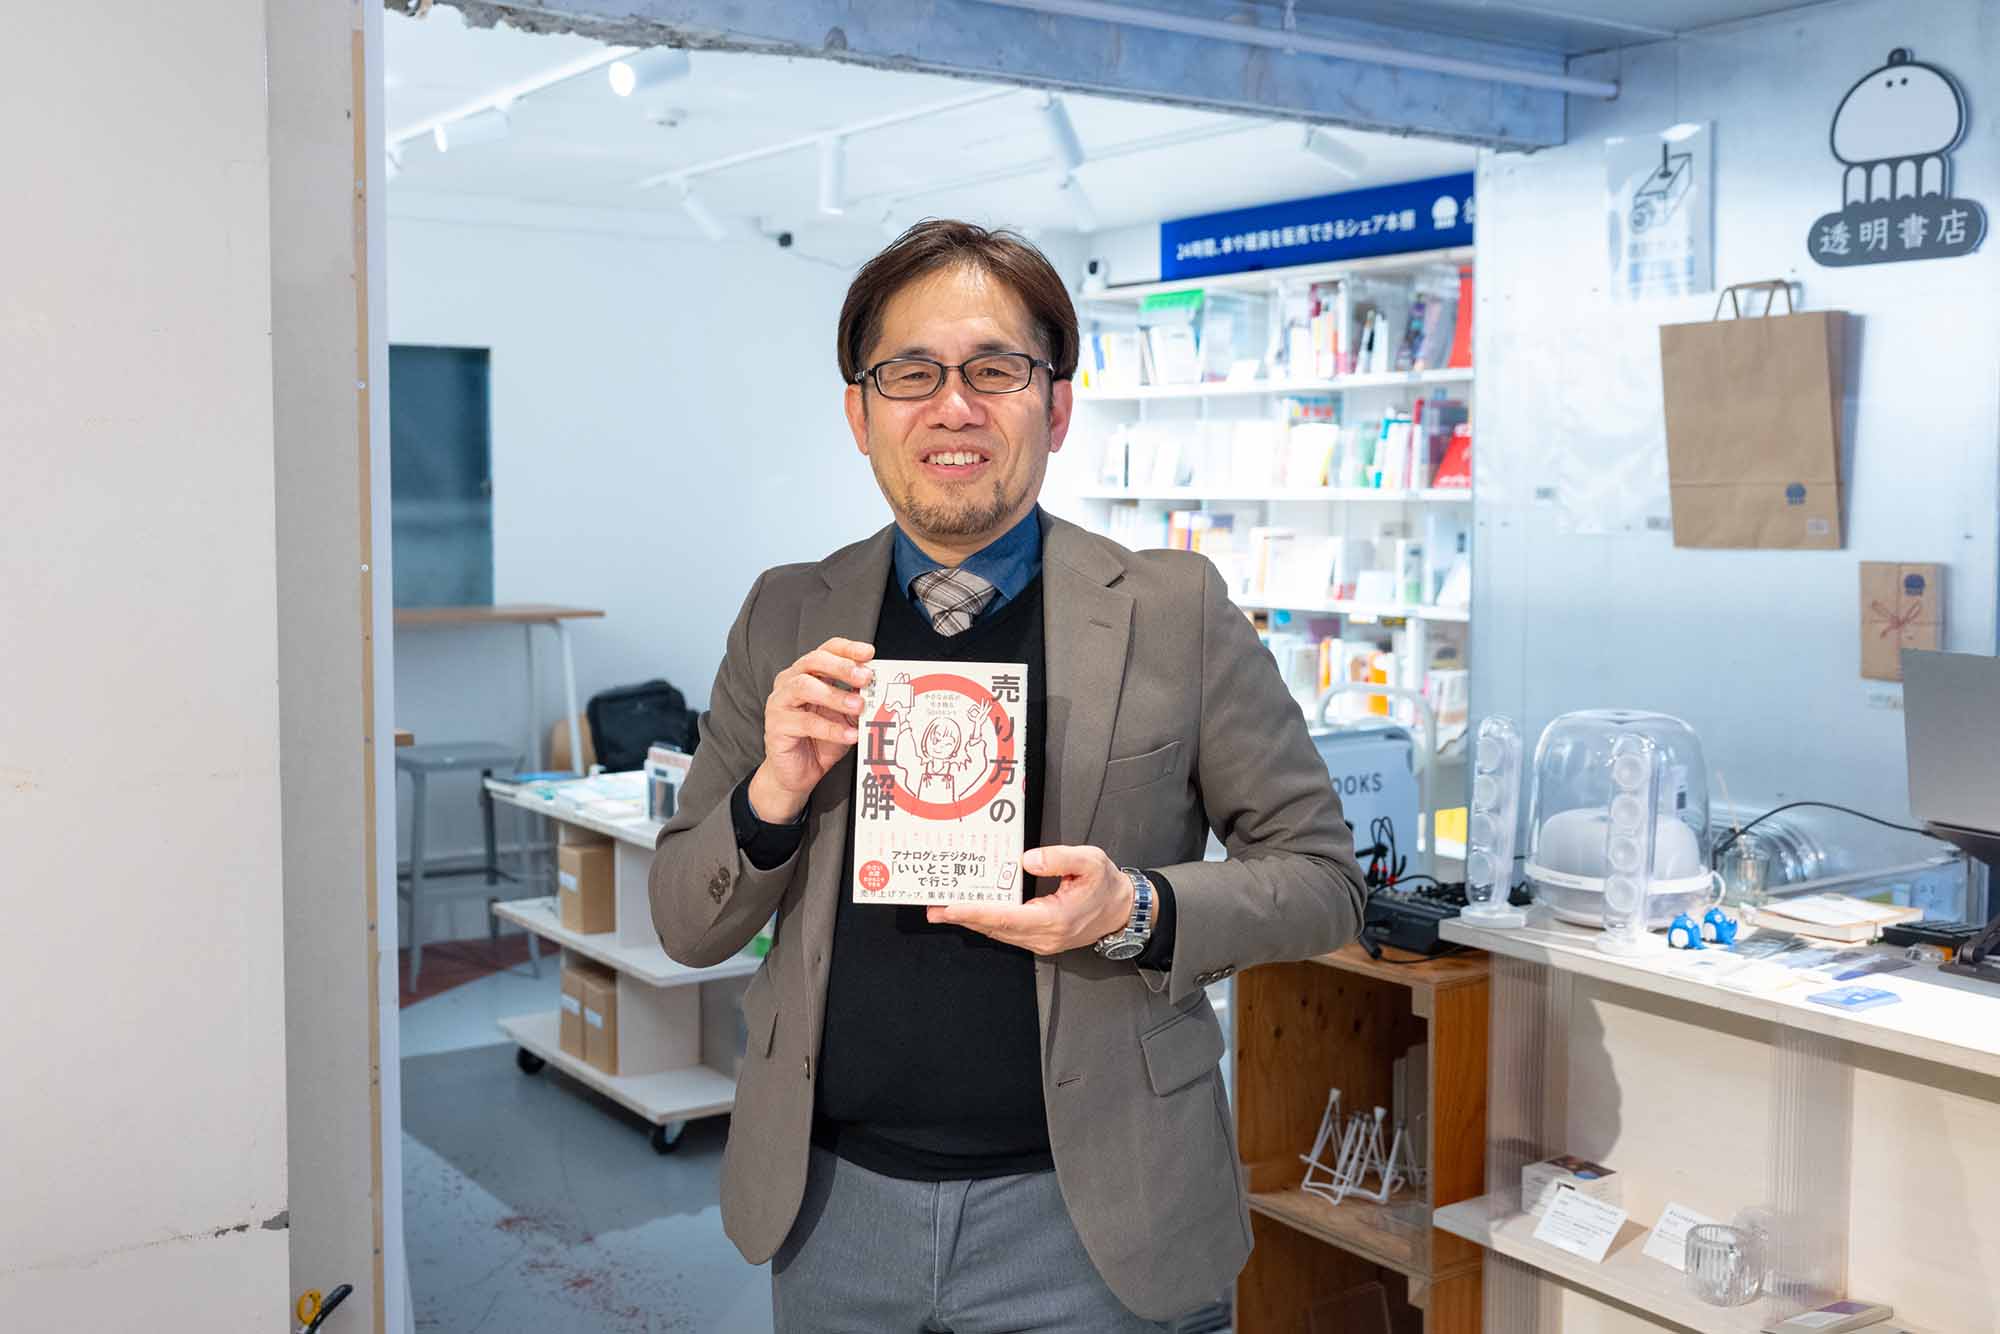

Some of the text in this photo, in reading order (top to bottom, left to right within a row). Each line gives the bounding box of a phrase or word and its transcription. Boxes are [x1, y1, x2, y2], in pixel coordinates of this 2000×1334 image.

[1819, 208, 1969, 255] 透明書店
[989, 674, 1021, 824] 売り方の
[861, 720, 897, 821] 正解
[1331, 772, 1382, 796] OOKS
[892, 850, 986, 862] アナログとデジタルの
[892, 861, 986, 877] 「いいとこ取り」
[918, 876, 960, 888] で行こう
